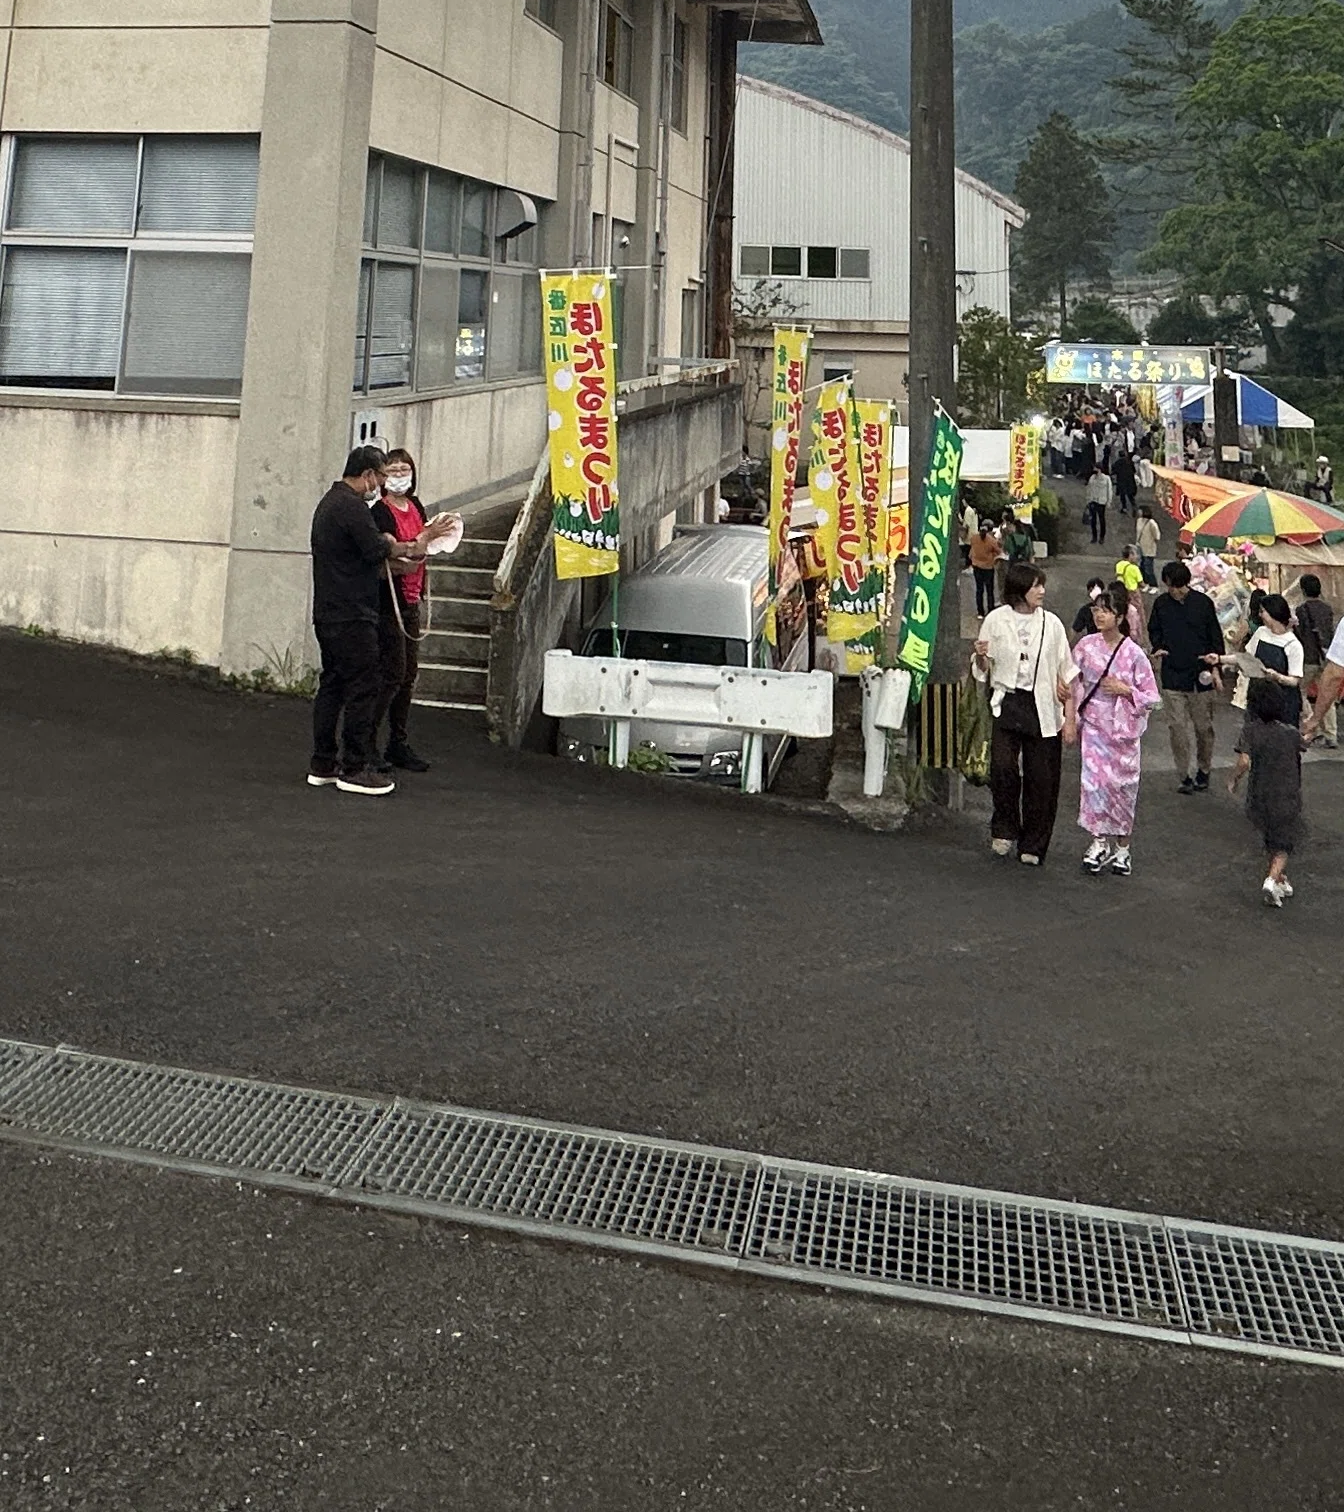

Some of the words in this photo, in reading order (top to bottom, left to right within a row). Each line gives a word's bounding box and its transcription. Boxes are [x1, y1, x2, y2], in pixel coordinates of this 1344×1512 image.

[1087, 361, 1182, 382] ほたる祭り
